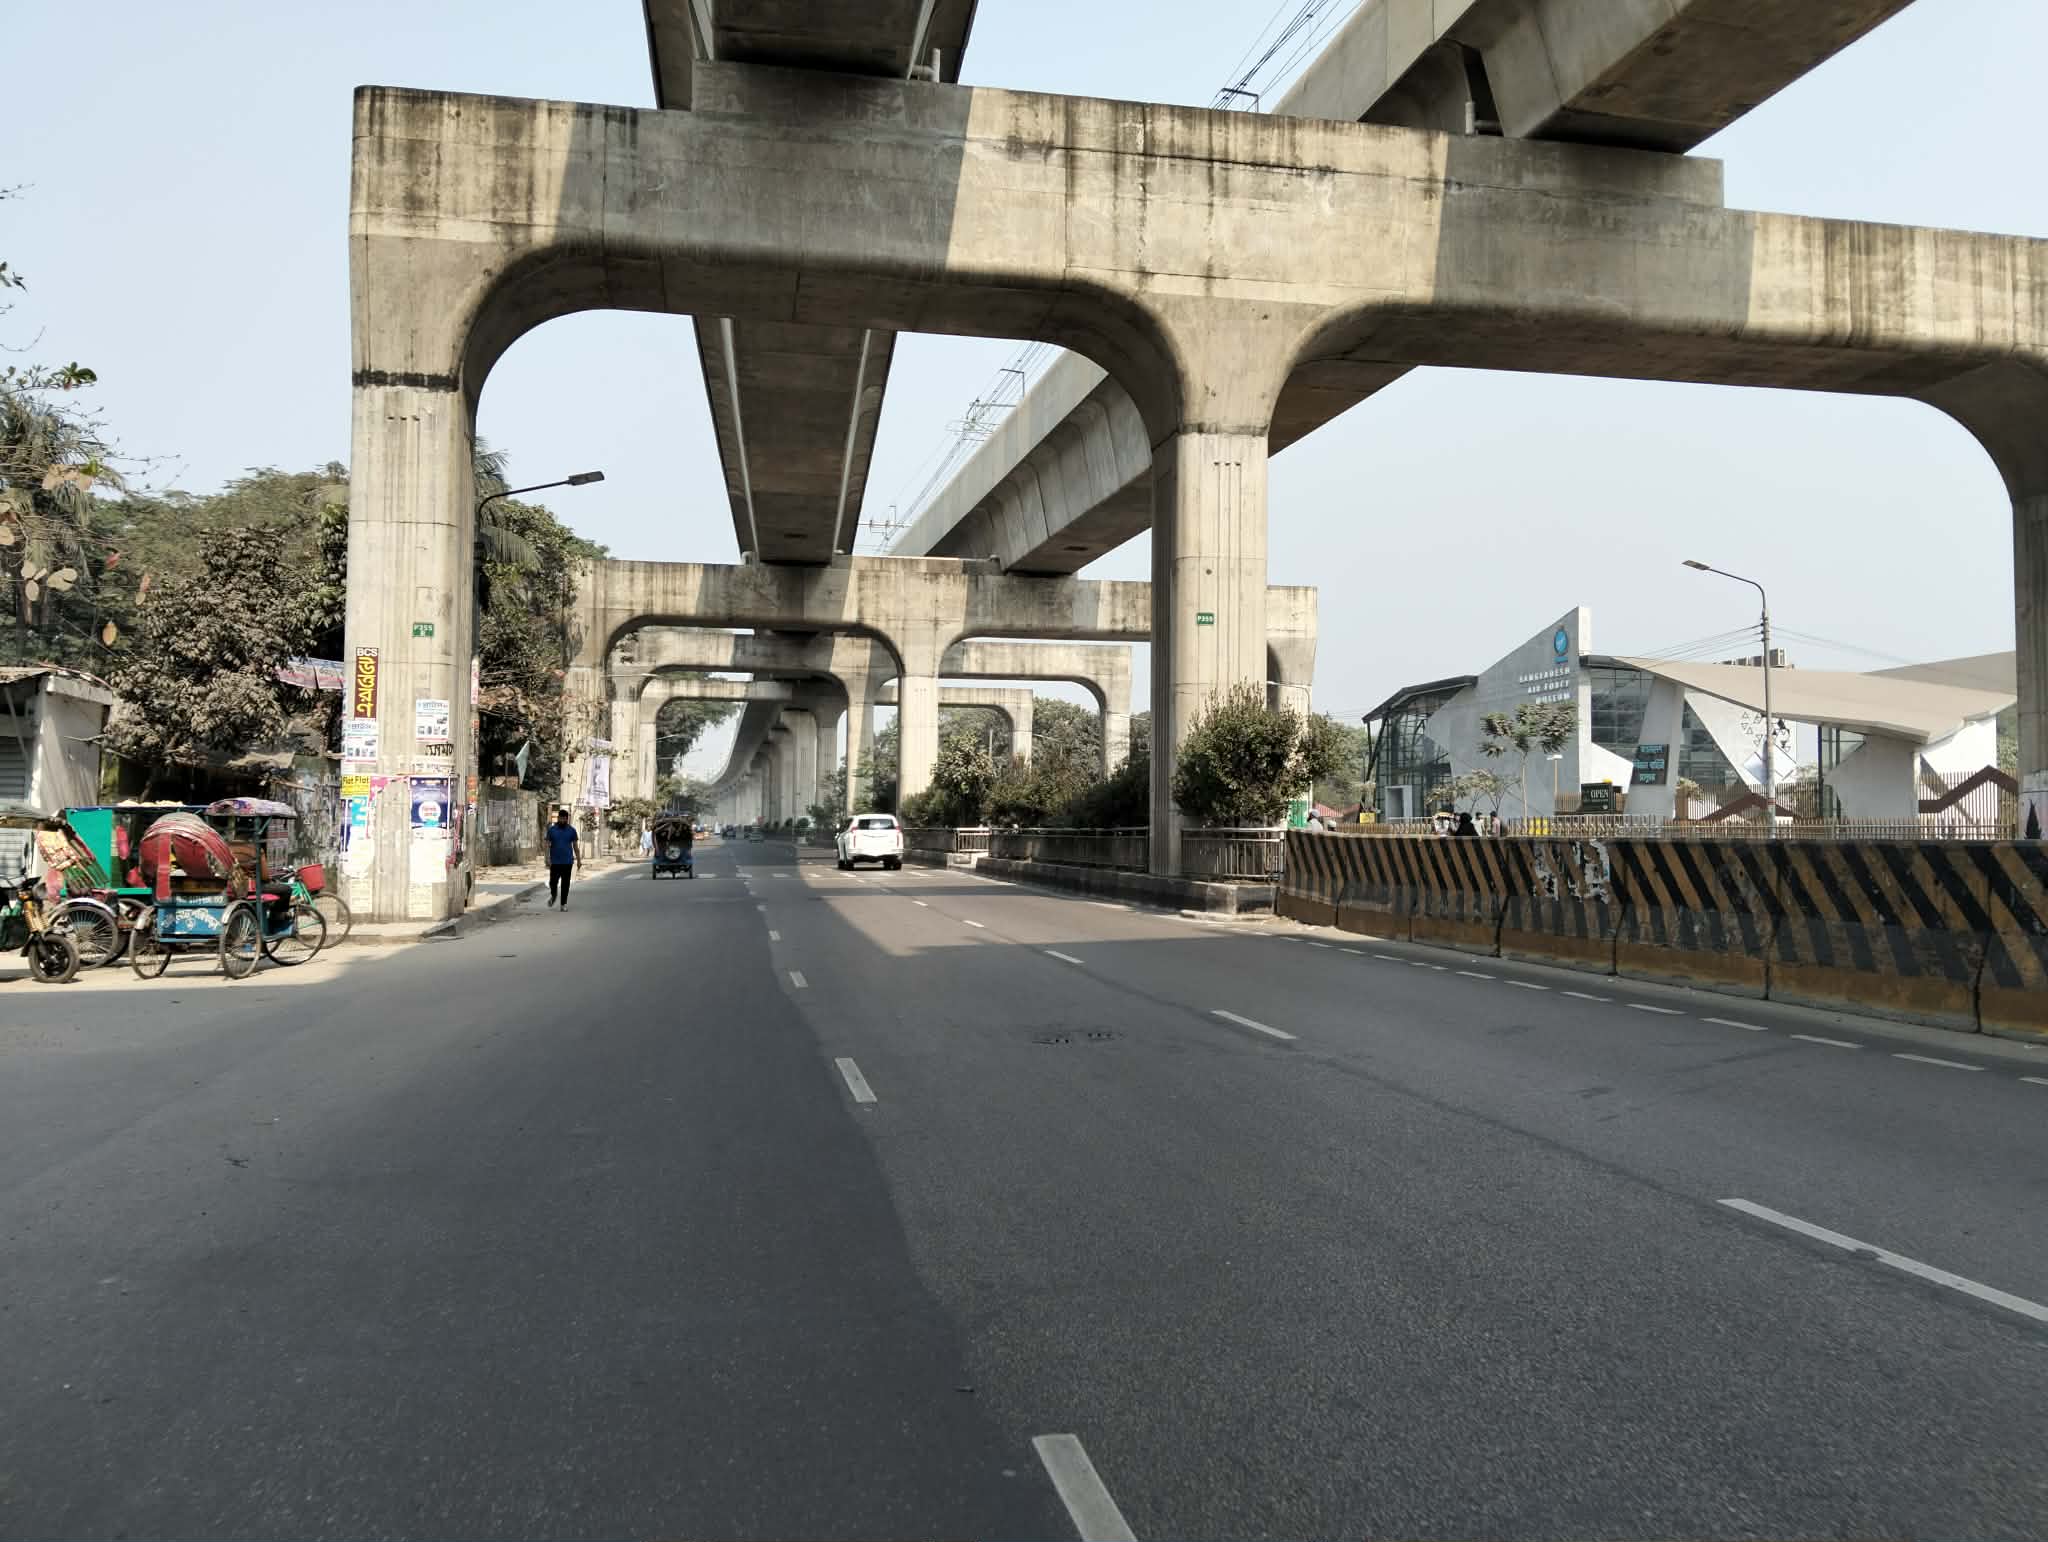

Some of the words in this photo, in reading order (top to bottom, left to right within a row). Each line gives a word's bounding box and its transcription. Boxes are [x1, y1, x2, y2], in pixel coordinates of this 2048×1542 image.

[356, 648, 378, 657] BCS
[1519, 667, 1570, 684] BANGLADESH
[1527, 685, 1541, 694] AIR
[1543, 679, 1570, 691] FORCE
[1535, 691, 1570, 704] MUSEUM
[1590, 789, 1609, 799] OPEN
